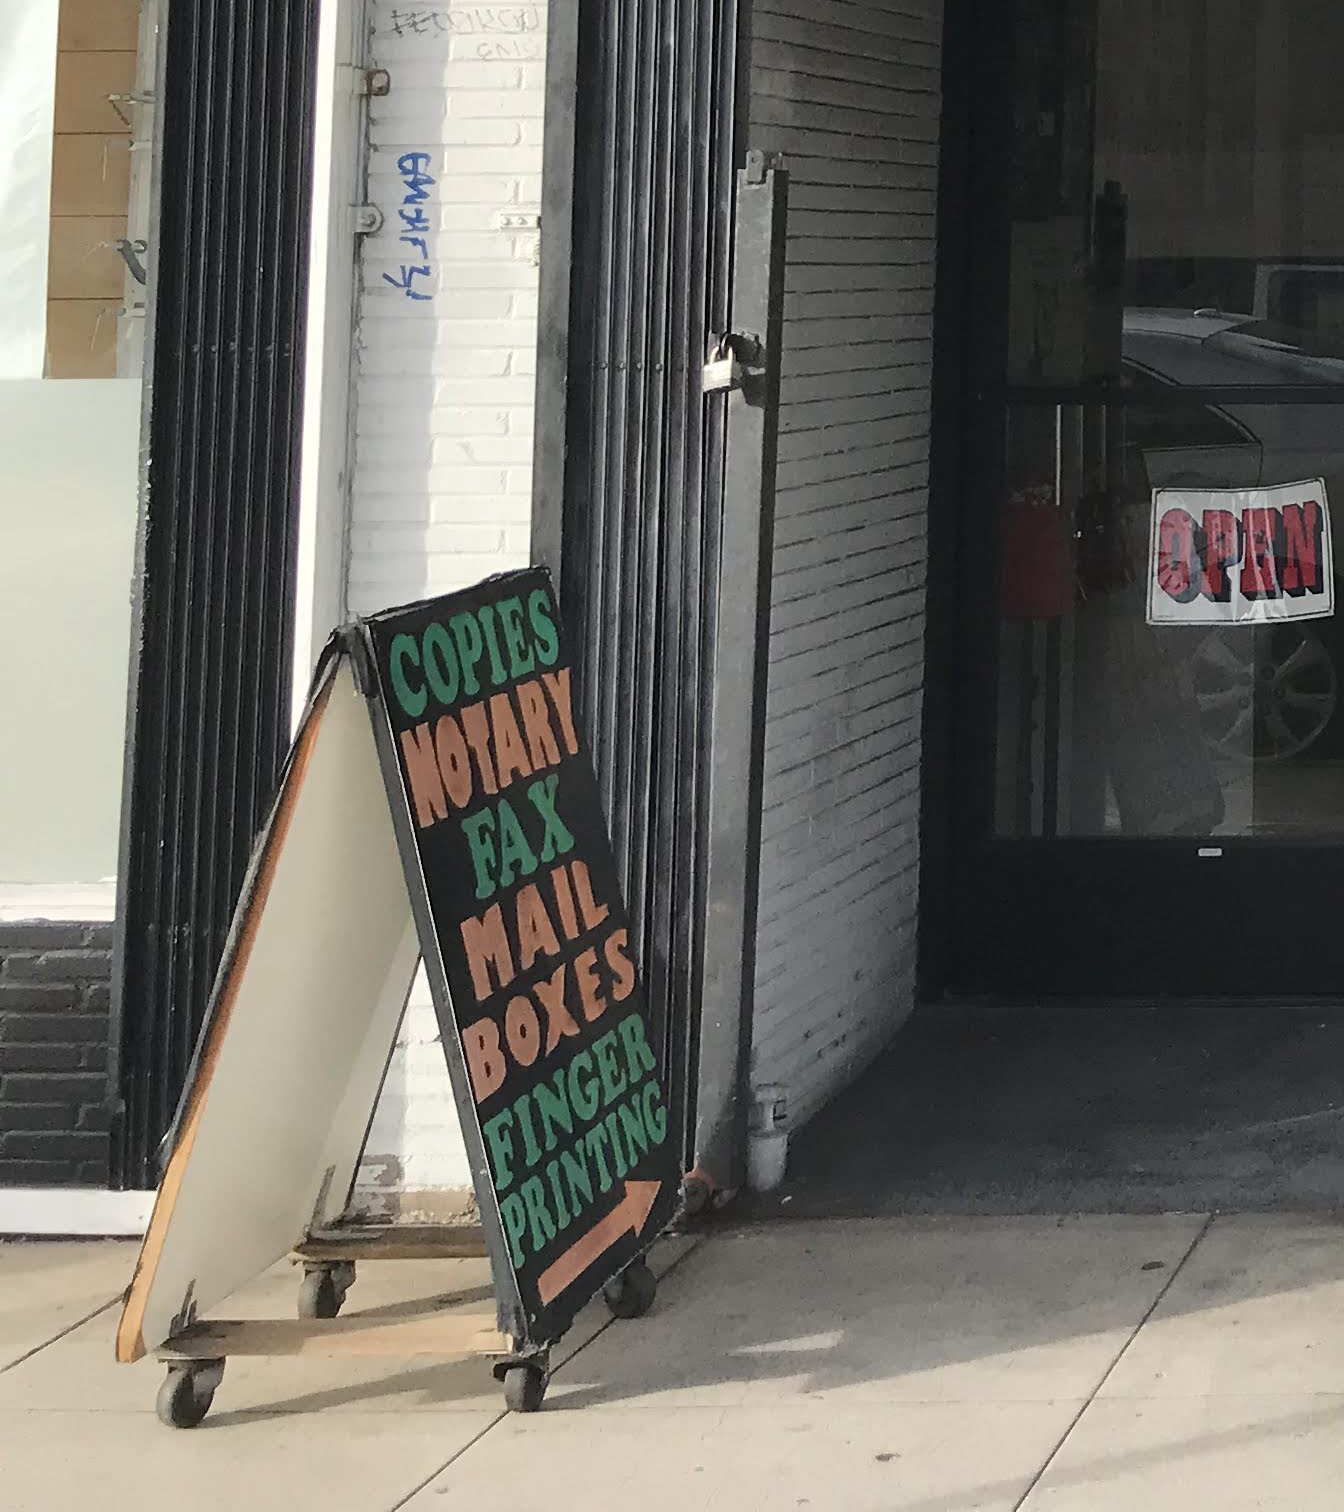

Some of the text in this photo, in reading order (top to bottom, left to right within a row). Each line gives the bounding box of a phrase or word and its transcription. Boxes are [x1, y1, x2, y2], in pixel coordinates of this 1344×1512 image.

[1158, 500, 1324, 603] OPEN
[390, 589, 560, 717] COPIES
[400, 667, 579, 829] NOTARY
[461, 774, 575, 899] FAX
[460, 860, 610, 1002] MAIL
[462, 928, 635, 1104] BOXES
[483, 1013, 657, 1190] FINGER
[500, 1079, 667, 1269] PRINTING
